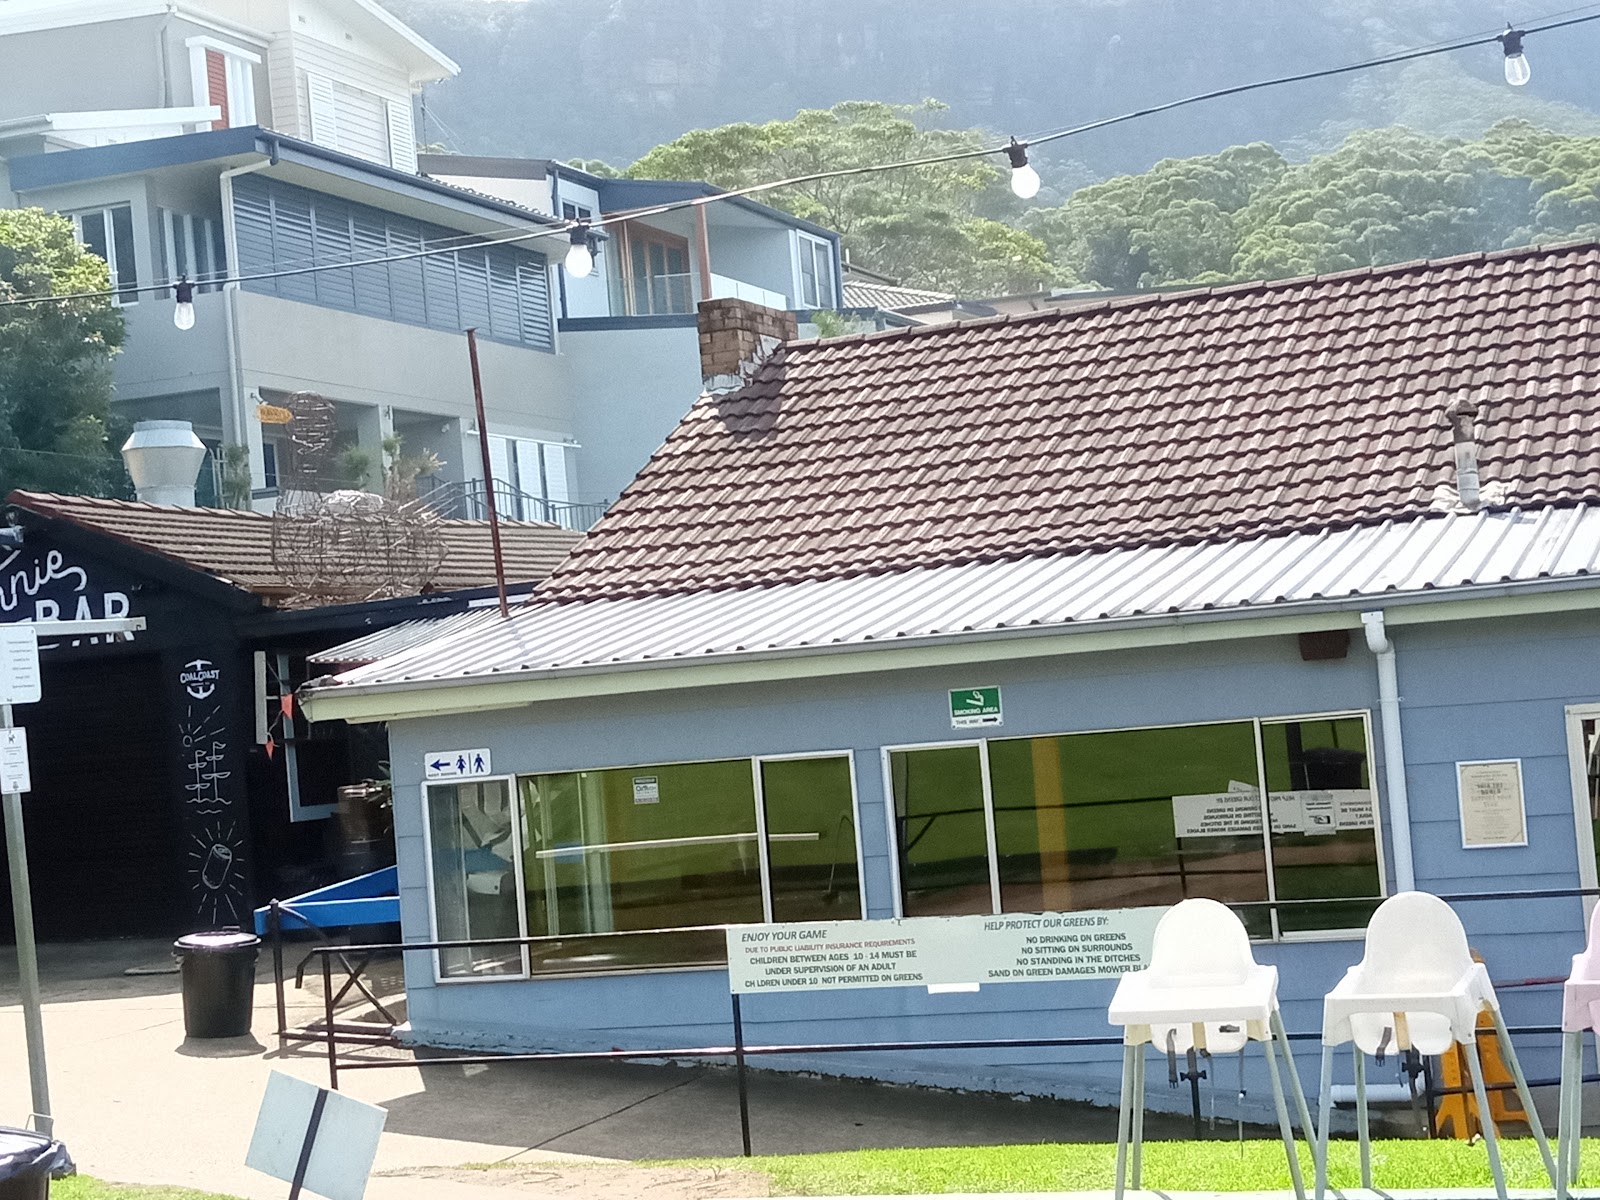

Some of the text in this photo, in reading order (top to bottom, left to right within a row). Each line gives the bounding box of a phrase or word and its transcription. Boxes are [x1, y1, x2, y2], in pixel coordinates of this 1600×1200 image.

[954, 708, 981, 716] SMOKING
[984, 916, 1109, 931] HELP PROTECT OUR GREENS BY:
[742, 930, 828, 942] ENJOY YOUR GAME
[1026, 933, 1127, 944] NO DRINKING ON GREENS
[795, 944, 824, 952] LIABILITY
[825, 942, 863, 950] INSURANCE
[864, 938, 916, 948] REQUIREMENTS
[1035, 946, 1066, 954] SITTING
[1082, 943, 1133, 952] SURROUNDS
[750, 956, 788, 965] CHILDREN
[790, 954, 826, 963] BETWEEN
[829, 953, 849, 961] AGES
[854, 952, 864, 960] 10
[882, 950, 904, 959] MUST
[906, 950, 917, 958] BE
[1016, 954, 1141, 966] NO STANDING IN THE DITCHES
[765, 967, 792, 975] UNDER
[794, 965, 845, 974] SUPERVISION
[871, 962, 897, 971] ADULT
[988, 970, 1011, 978] SAND
[1026, 968, 1054, 976] GREEN
[1056, 967, 1096, 975] DAMAGES
[1098, 965, 1130, 974] MOWER
[1133, 964, 1150, 972] BLA
[782, 978, 807, 986] UNDER
[822, 976, 837, 984] NOT
[838, 975, 880, 984] PERMITTED
[881, 974, 892, 982] ON
[894, 973, 923, 981] GREENS
